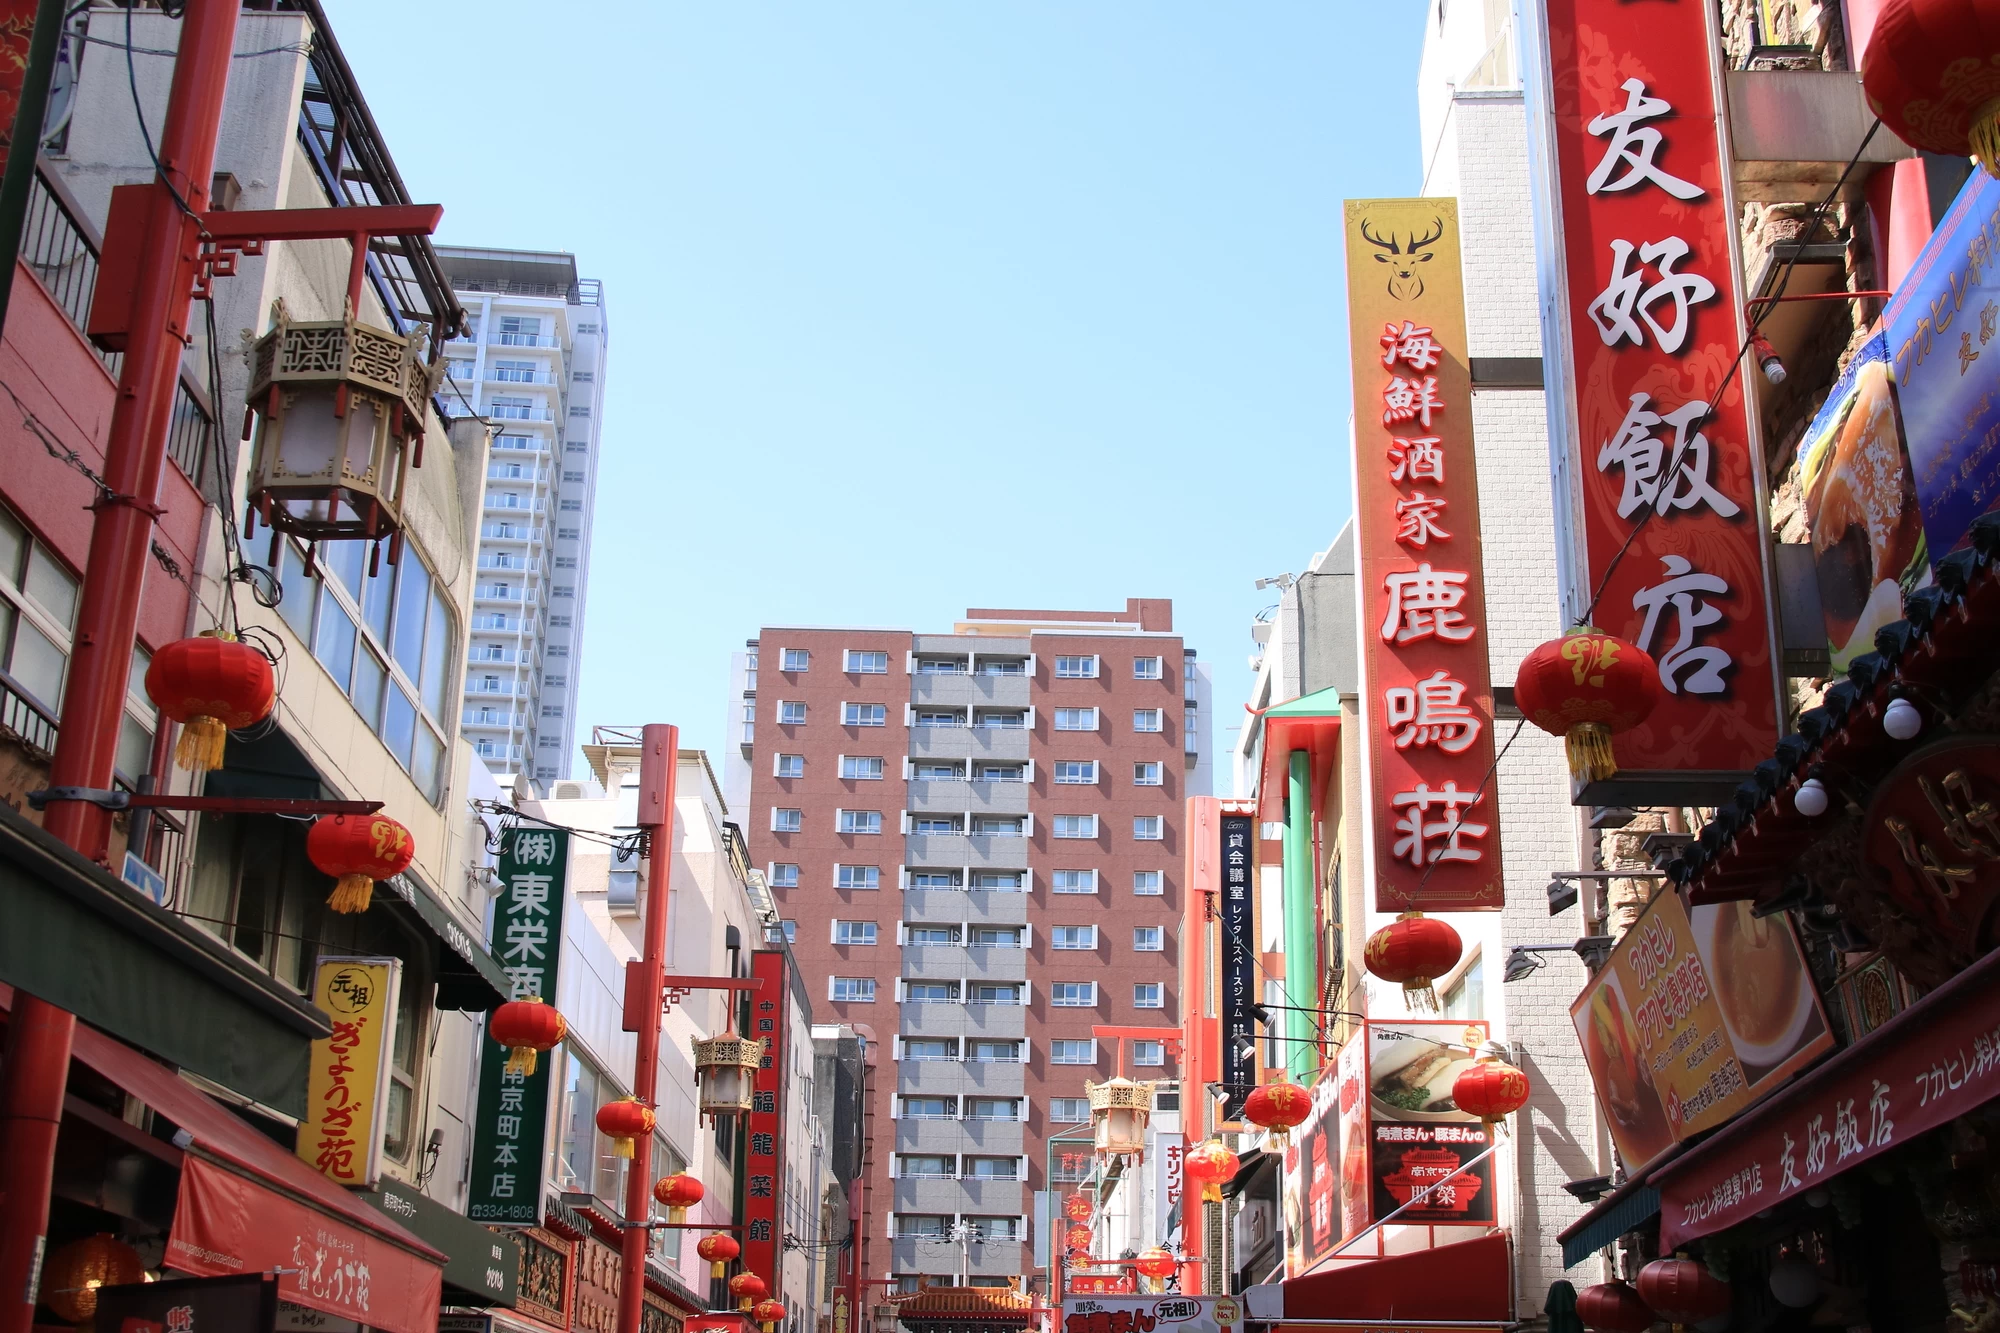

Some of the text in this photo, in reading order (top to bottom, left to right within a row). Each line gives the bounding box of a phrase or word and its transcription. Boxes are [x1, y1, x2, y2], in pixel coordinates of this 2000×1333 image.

[1382, 320, 1452, 548] 海鮮酒家
[1586, 76, 1741, 697] 友好飯店
[1380, 562, 1491, 869] 鹿鳴荘
[1228, 834, 1245, 900] 貸会議室
[500, 830, 558, 1004] (株)東栄商
[1628, 913, 1676, 990] フカヒレ
[332, 974, 369, 1007] 元祖
[316, 1016, 368, 1180] ぎょうざ苑
[1376, 1126, 1485, 1142] 角煮まん・豚まんの
[1779, 1078, 1892, 1195] 友好飯店
[481, 1204, 536, 1219] 334-1808
[748, 1090, 776, 1243] 福龍菜館
[172, 1238, 244, 1270] www.ganso-gyozaen.com
[1158, 1302, 1195, 1318] 元祖!!
